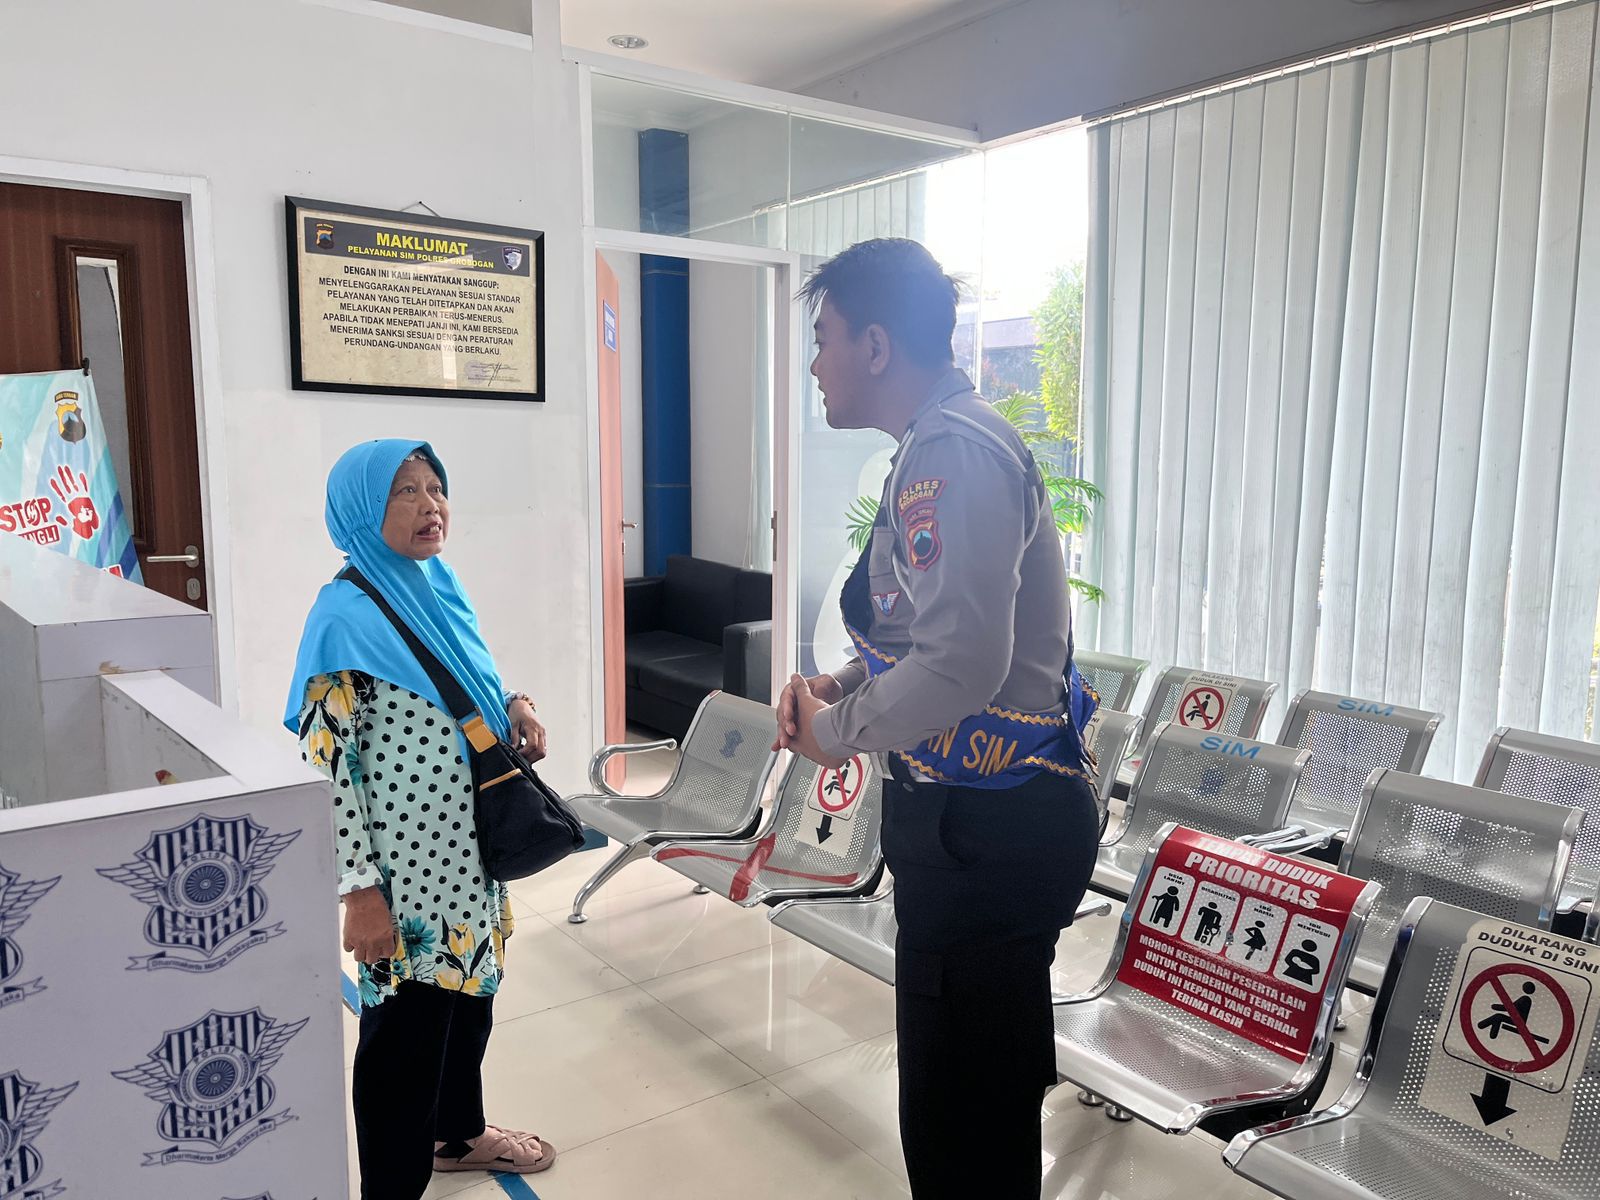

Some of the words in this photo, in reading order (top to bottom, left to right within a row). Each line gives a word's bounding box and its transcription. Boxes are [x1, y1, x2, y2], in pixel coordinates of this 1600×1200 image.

[347, 245, 398, 258] PELAYANAN
[399, 251, 415, 260] SIM
[417, 253, 449, 264] POLRES
[450, 257, 494, 269] GROBOGAN
[376, 232, 468, 256] MAKLUMAT
[319, 277, 409, 293] MENYELENGGARAKAN
[411, 286, 457, 298] PELAYANAN
[458, 290, 485, 300] SESUAI
[487, 293, 520, 303] STANDAR
[344, 265, 376, 277] DENGAN
[378, 269, 389, 278] INI
[391, 270, 411, 281] KAMI
[412, 273, 461, 286] MENYATAKAN
[463, 278, 499, 289] SANGGUP:
[327, 290, 376, 302] PELAYANAN
[378, 295, 399, 304] YANG
[401, 296, 427, 306] TELAH
[428, 299, 475, 310] DITETAPKAN
[477, 303, 493, 312] DAN
[493, 305, 514, 314] AKAN
[340, 302, 391, 314] MELAKUKAN
[393, 307, 438, 318] PERBAIKAN
[440, 311, 504, 323] TERUS-MENERUS.
[322, 313, 358, 323] APABILA
[360, 315, 384, 325] TIDAK
[386, 318, 425, 328] MENEPATI
[426, 321, 447, 330] JANJI
[462, 324, 480, 332] KAMI
[482, 325, 519, 335] BERSEDIA
[330, 325, 373, 336] MENERIMA
[375, 328, 405, 338] SANKSI
[406, 330, 434, 340] SESUAI
[436, 333, 468, 342] DENGAN
[469, 335, 513, 345] PERATURAN
[344, 338, 441, 351] PERUNDANG-UNDANGAN
[443, 344, 463, 353] YANG
[0, 498, 51, 532] STOP
[963, 730, 1018, 776] SIM
[1199, 837, 1265, 866] TEMPAT
[1262, 857, 1334, 890] DUDUK
[1184, 851, 1320, 909] PRIORITAS
[1201, 886, 1236, 902] DISABILITAS
[1478, 932, 1537, 956] DUDUK
[1540, 950, 1559, 962] DI
[1562, 956, 1600, 974] SINI
[1501, 926, 1587, 957] DILARANG
[1139, 934, 1175, 956] MOHON
[1175, 949, 1231, 979] KESEDIAAN
[1232, 972, 1278, 1000] PESERTA
[1280, 993, 1307, 1012] LAIN
[1145, 950, 1178, 971] UNTUK
[1178, 964, 1247, 1000] MEMBERIKAN
[1249, 993, 1293, 1020] TEMPAT
[1133, 958, 1167, 981] DUDUK
[1167, 973, 1183, 987] INI
[1182, 980, 1222, 1005] KEPADA
[1224, 996, 1252, 1018] YANG
[1252, 1010, 1299, 1038] BERHAK
[1171, 988, 1210, 1013] TERIMA
[1209, 1006, 1244, 1028] KASIH
